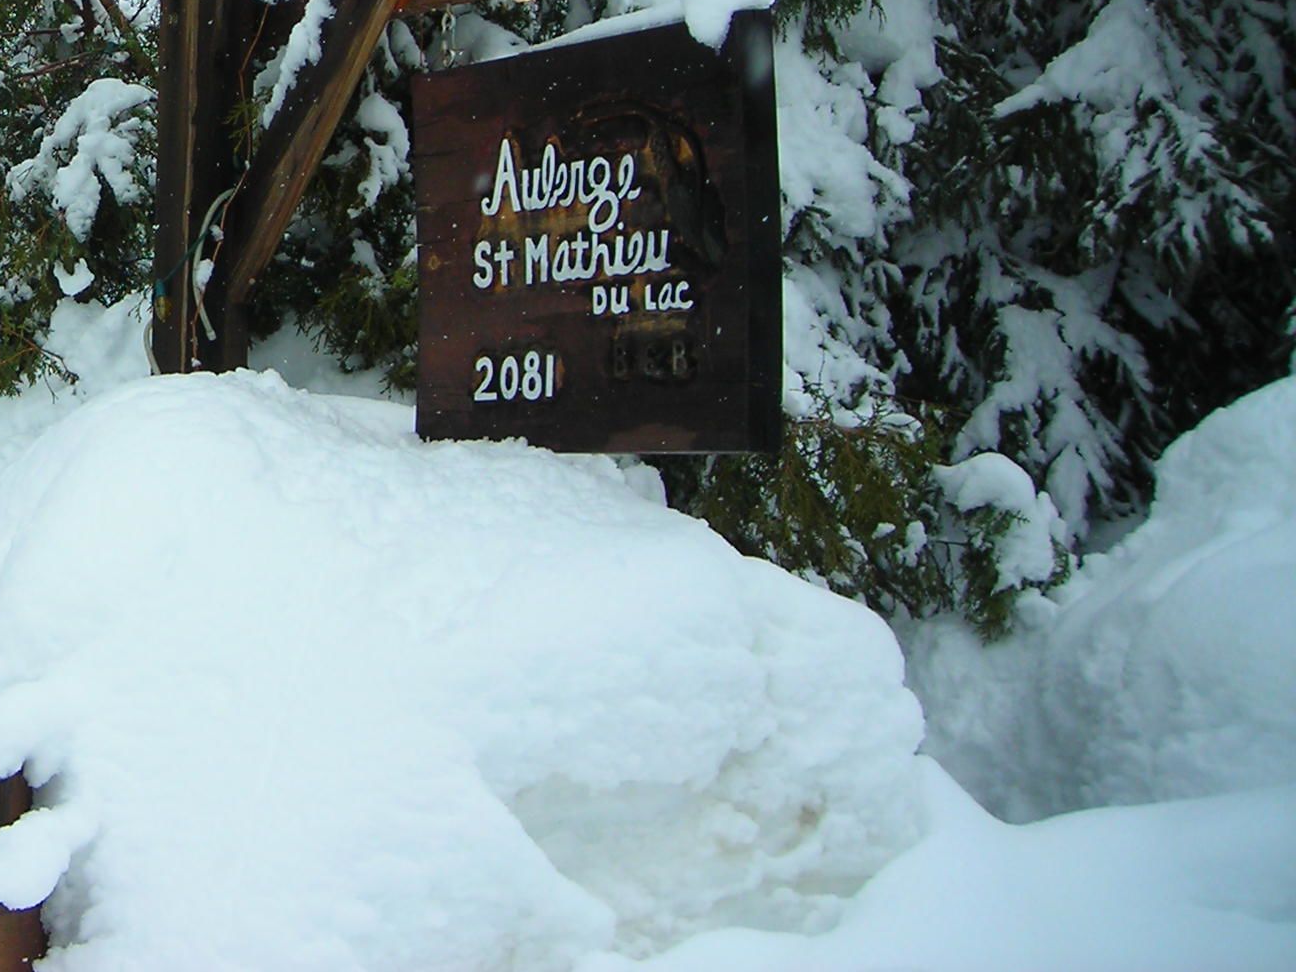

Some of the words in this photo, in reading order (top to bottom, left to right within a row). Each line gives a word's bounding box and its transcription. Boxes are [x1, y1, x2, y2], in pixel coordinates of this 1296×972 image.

[481, 138, 642, 232] Auberge
[473, 240, 513, 289] St
[525, 224, 671, 285] Mathieu
[473, 350, 556, 401] 2081
